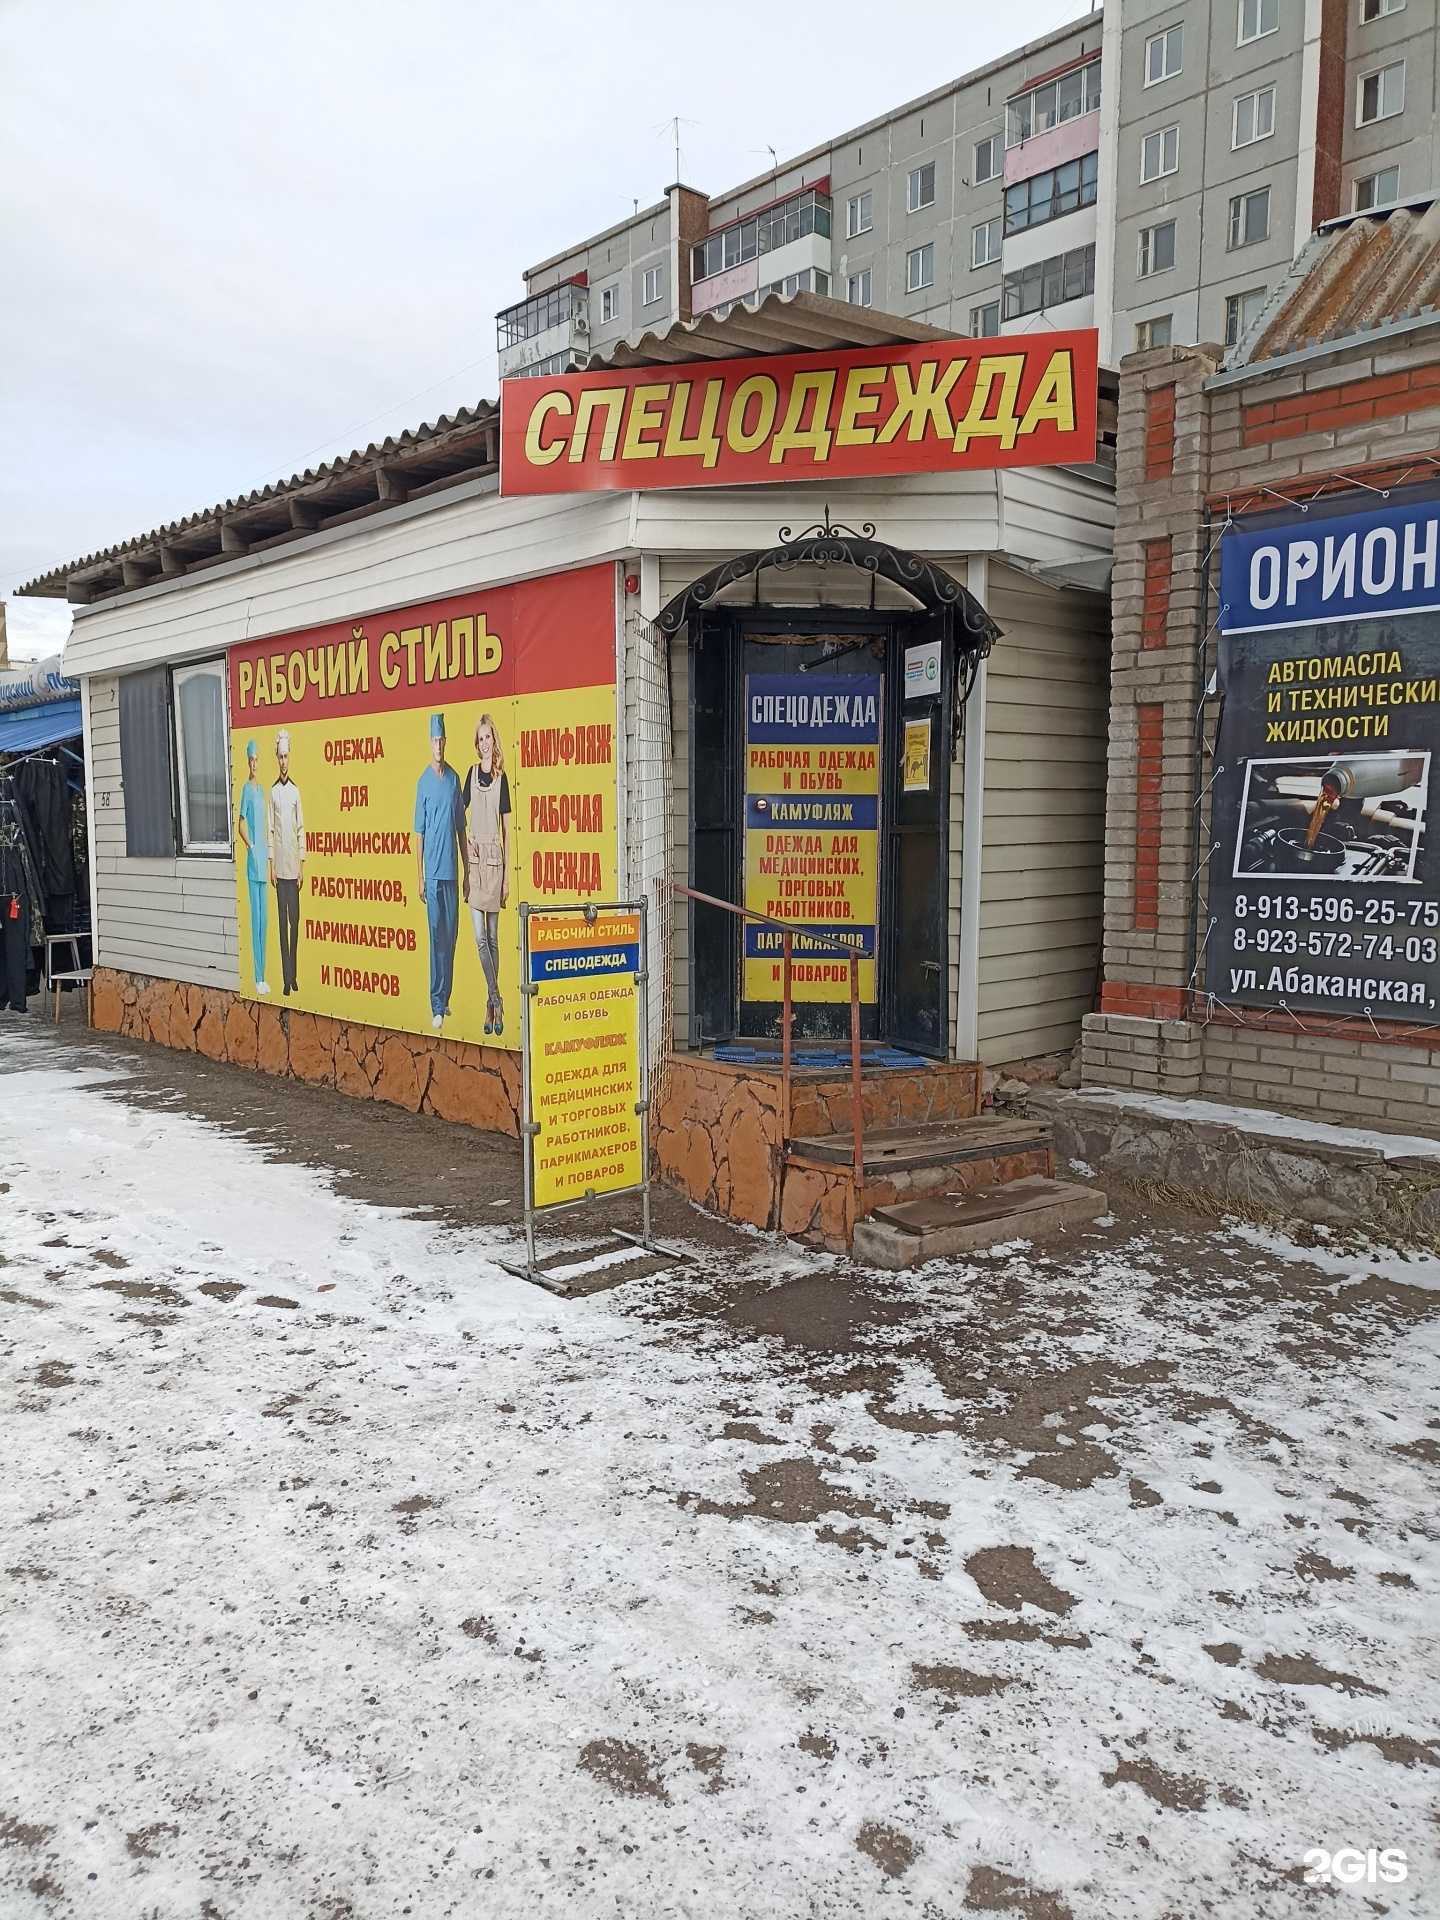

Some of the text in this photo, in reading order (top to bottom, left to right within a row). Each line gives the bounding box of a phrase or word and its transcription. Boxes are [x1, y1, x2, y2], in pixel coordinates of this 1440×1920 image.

[523, 349, 1078, 469] СПЕЦОДЕЖДА
[1249, 519, 1438, 610] ОРИОН
[238, 612, 504, 709] РАБОЧИЙ СТИЛЬ
[1268, 651, 1402, 684] АВТОМАСЛА
[1267, 679, 1440, 713] И ТЕХНИЧЕСКИ
[751, 695, 877, 728] СПЕЦОДЕЖДА
[1265, 714, 1389, 743] ЖИДКОСТИ
[324, 736, 385, 766] ОДЕЖДА
[520, 724, 612, 768] КАМУФЛЯЖ
[750, 750, 876, 771] РАБОЧАЯ ОДЕЖДА
[783, 772, 843, 790] И ОБУВЬ
[340, 785, 369, 812] ДЛЯ
[771, 803, 853, 821] КАМУФЛЯЖ
[530, 794, 603, 834] РАБОЧАЯ
[305, 831, 412, 858] МЕДИЦИНСКИХ
[766, 835, 858, 855] ОДЕЖДА ДЛЯ
[532, 850, 602, 896] ОДЕЖДА
[759, 857, 864, 877] МЕДИЦИНСКИХ,
[311, 876, 407, 908] РАБОТНИКОВ,
[778, 879, 845, 897] ТОРГОВЫХ
[767, 900, 855, 920] РАБОТНИКОВ,
[1234, 894, 1439, 928] 8-913-596-25-75
[305, 919, 417, 952] ПАРИКМАХЕРОВ
[597, 923, 635, 937] СТИЛЬ
[1233, 927, 1437, 964] 8-923-572-74-03
[544, 952, 627, 972] СПЕЦОДЕЖДА
[772, 965, 848, 982] И ПОВАРОВ
[321, 964, 400, 997] И ПОВАРОВ
[537, 987, 634, 1007] РАБОЧАЯ ОДЕЖДА
[563, 1008, 609, 1021] И ОБУВЬ
[544, 1032, 627, 1056] КАМУФЛЯЖ
[545, 1061, 627, 1085] ОДЕЖДА ДЛЯ
[540, 1081, 633, 1106] МЕДИЦИНСКИХ
[549, 1102, 627, 1126] И ТОРГОВЫХ
[540, 1140, 638, 1170] ПАРИКМАХЕРОВ
[555, 1163, 625, 1187] И ПОВАРОВ
